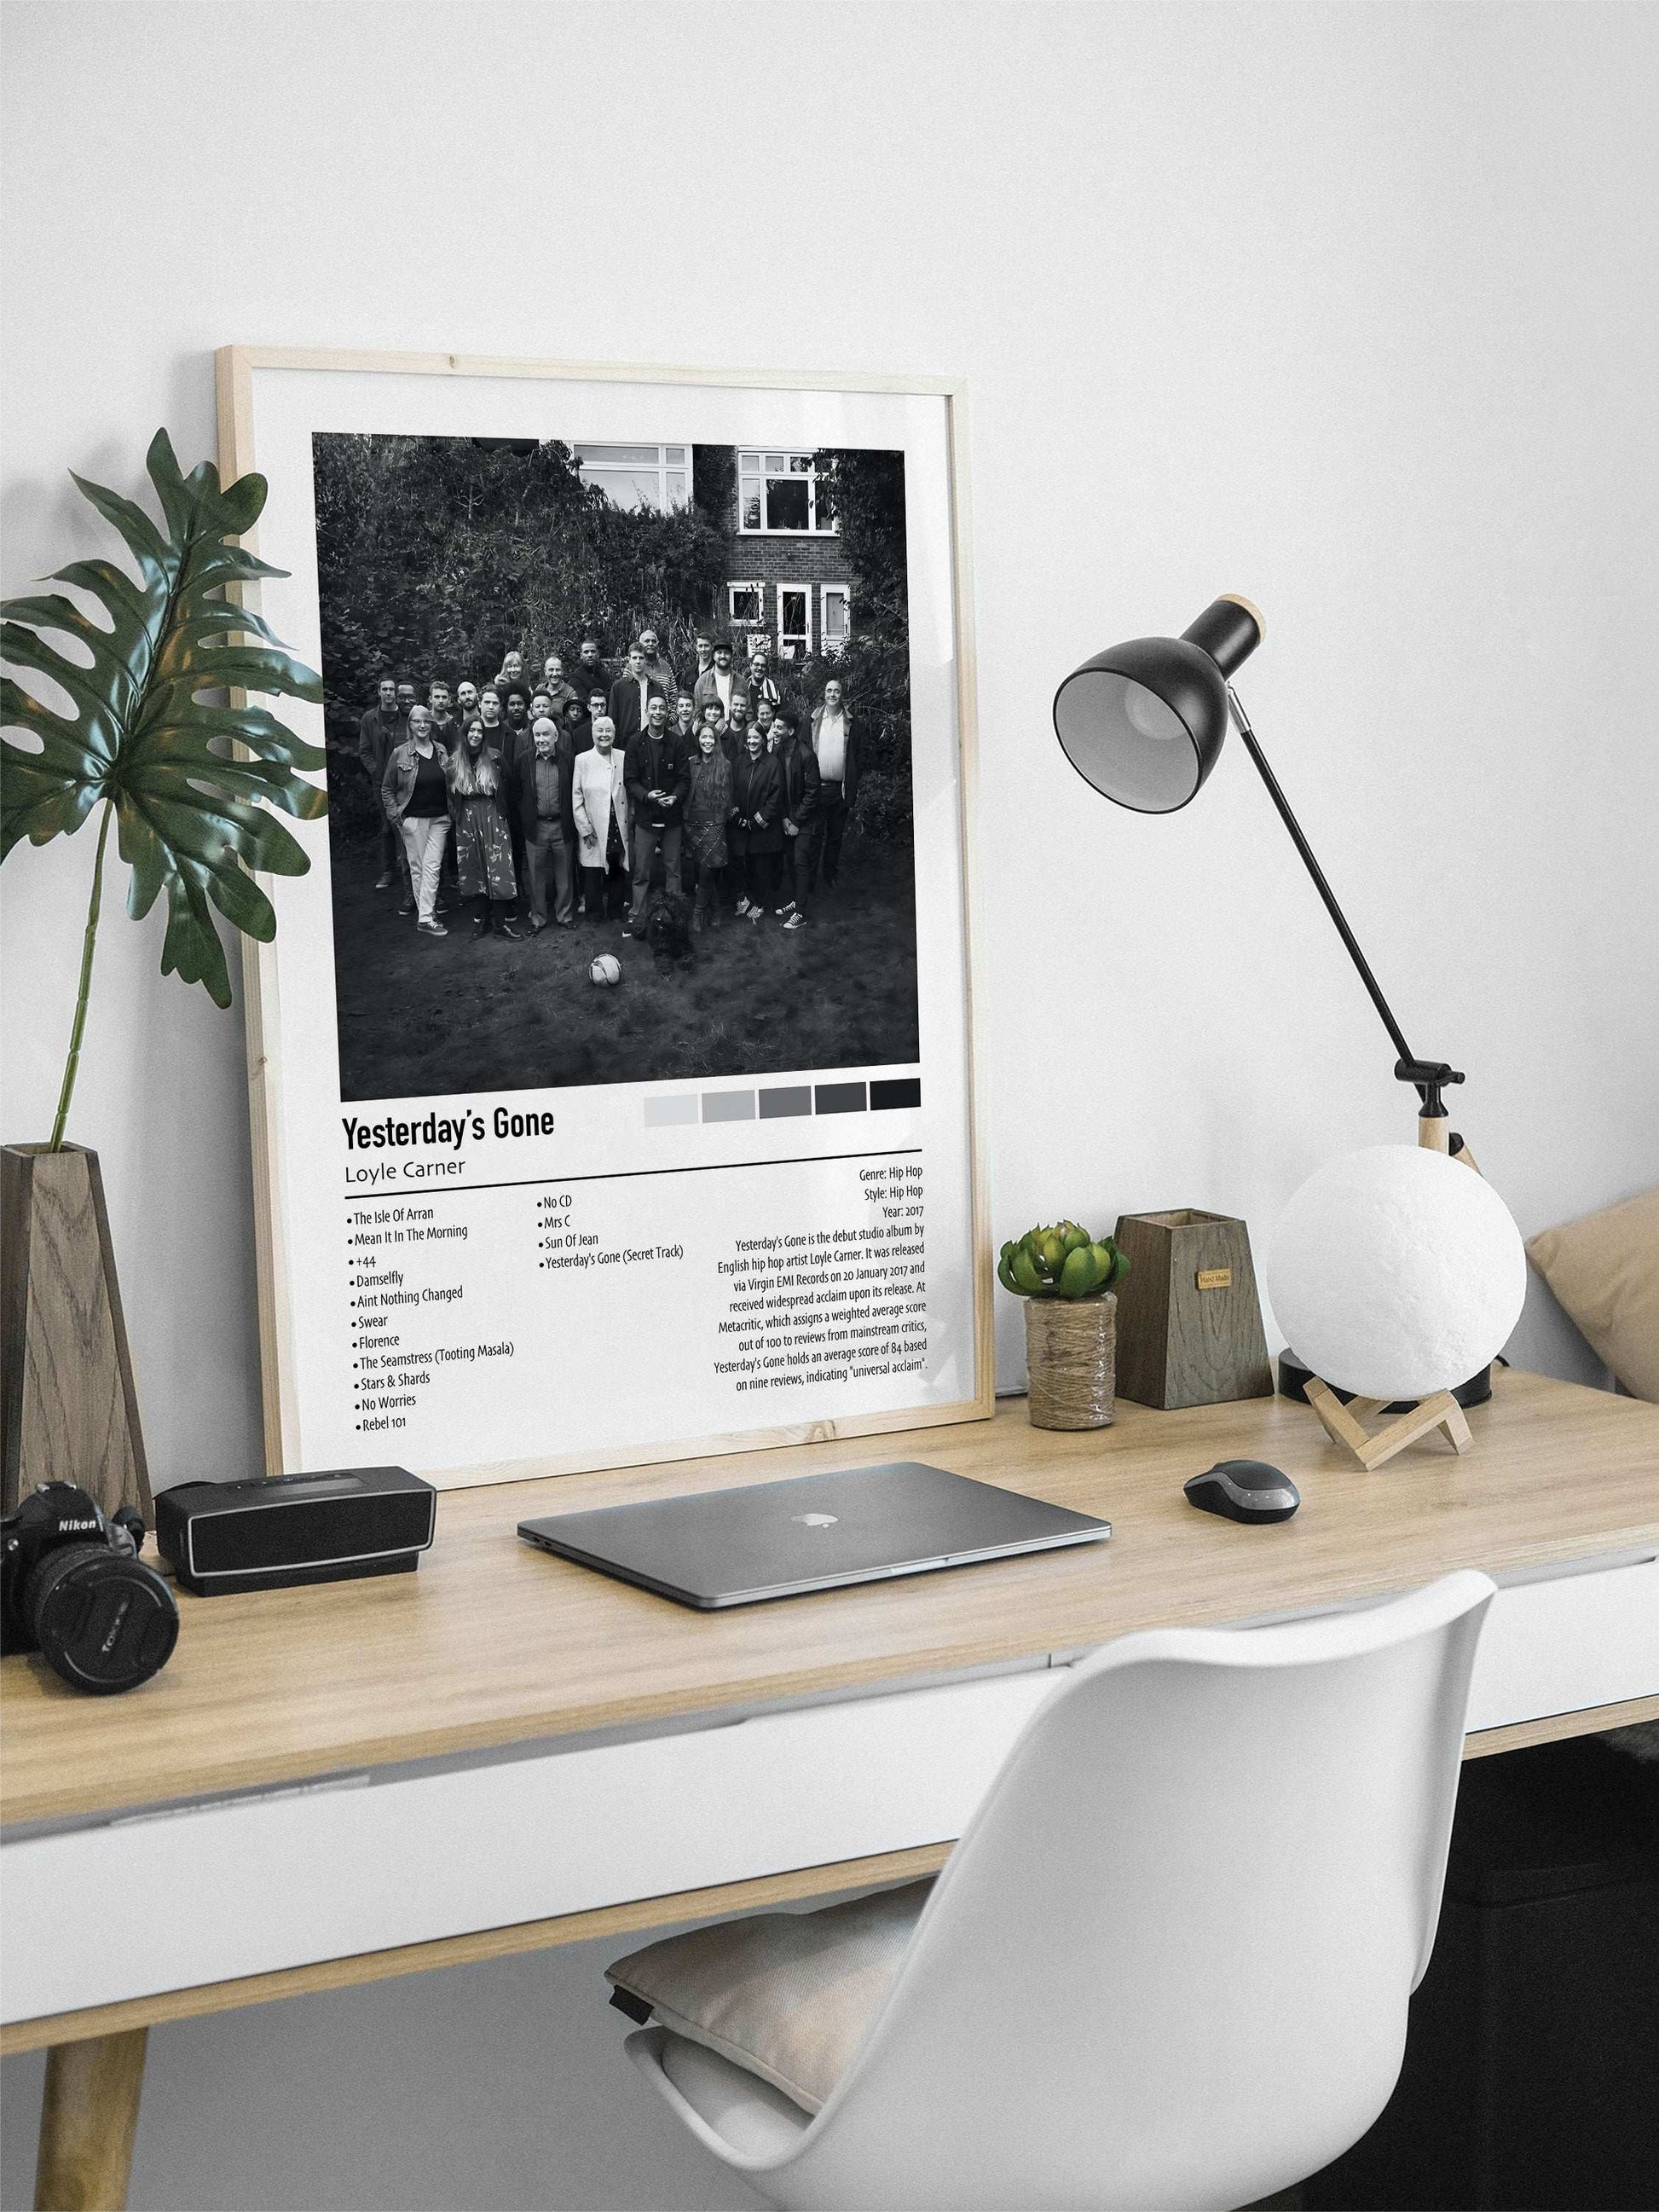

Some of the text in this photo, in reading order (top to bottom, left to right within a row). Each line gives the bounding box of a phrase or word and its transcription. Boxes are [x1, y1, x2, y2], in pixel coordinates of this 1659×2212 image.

[342, 1107, 554, 1150] Yesterday's Gone
[345, 1161, 465, 1185] Loyle Carner
[859, 1166, 922, 1181] Genre: Hip Hop
[544, 1195, 572, 1208] No CD
[864, 1185, 923, 1203] Style: Hip Hop
[353, 1207, 433, 1225] The Isle Of Arran
[544, 1214, 570, 1229] Mrs C
[882, 1206, 924, 1218] Year: 2017
[355, 1226, 467, 1246] Mean It In The Morning
[545, 1233, 598, 1249] Sun Of Jean
[735, 1223, 924, 1252] Yesterday's Gone is the debut studio album by
[356, 1256, 376, 1268] +44
[546, 1244, 683, 1269] Yesterday's Gone (Secret Track)
[718, 1241, 924, 1277] English hip hop artist Loyle Carner. It was released
[356, 1271, 403, 1288] Damselfly
[733, 1260, 925, 1293] via Virgin EMI Records on 20 January 2017 and
[357, 1285, 463, 1308] Aint Nothing Changed
[730, 1281, 926, 1312] received widespread acclaim upon its release. At
[358, 1316, 388, 1329] Swear
[719, 1302, 927, 1334] Metacritic, which assigns a weighted average score
[359, 1335, 400, 1349] Florence
[738, 1320, 927, 1352] out of 100 to reviews from mainstream critics,
[360, 1341, 514, 1369] The Seamstress (Tooting Masala)
[714, 1337, 927, 1374] Yesterday's Gone holds an average score of 84 based
[361, 1370, 431, 1391] Stars & Shards
[736, 1358, 928, 1392] on nine reviews, indicating "universal acclaim".
[362, 1393, 416, 1411] No Worries
[363, 1416, 406, 1432] Rebel 101
[58, 1519, 96, 1532] Nikon
